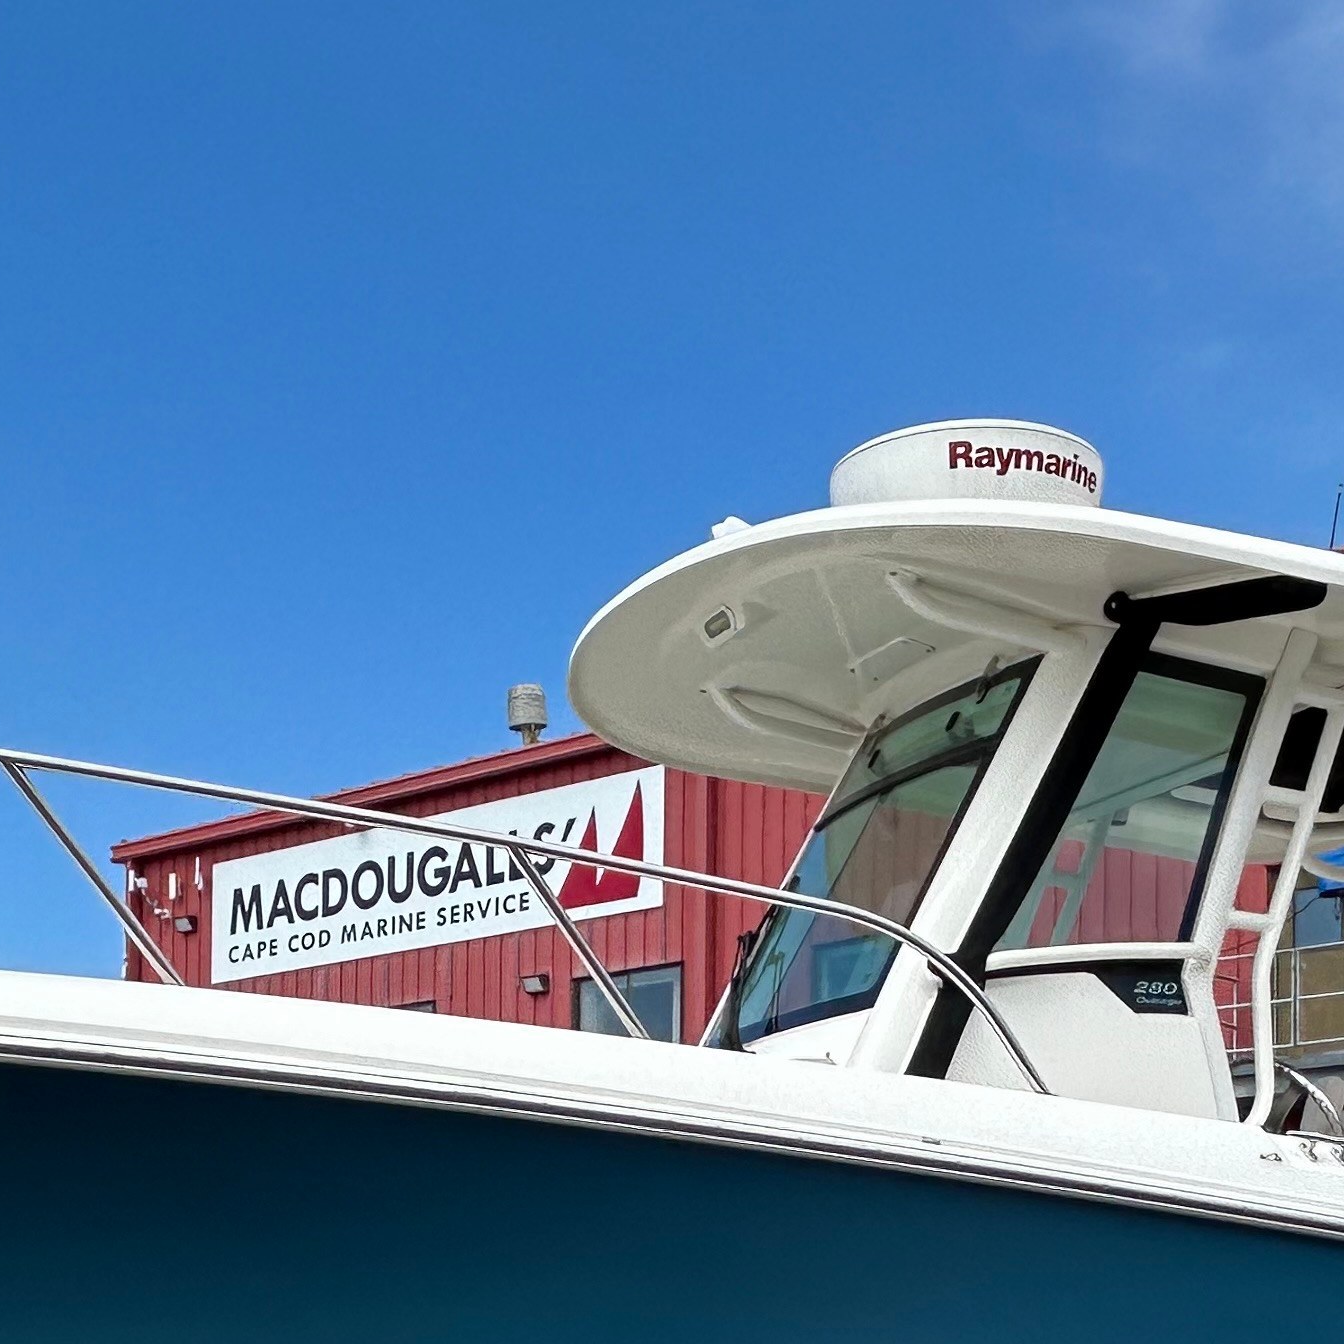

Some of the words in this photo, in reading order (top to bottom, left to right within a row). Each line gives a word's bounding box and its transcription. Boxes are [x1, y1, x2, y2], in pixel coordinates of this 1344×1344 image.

[948, 441, 1098, 494] Raymarine
[228, 938, 279, 964] CAPE
[288, 929, 331, 953] COD
[340, 910, 427, 944] MARINE
[436, 892, 531, 927] SERVICE
